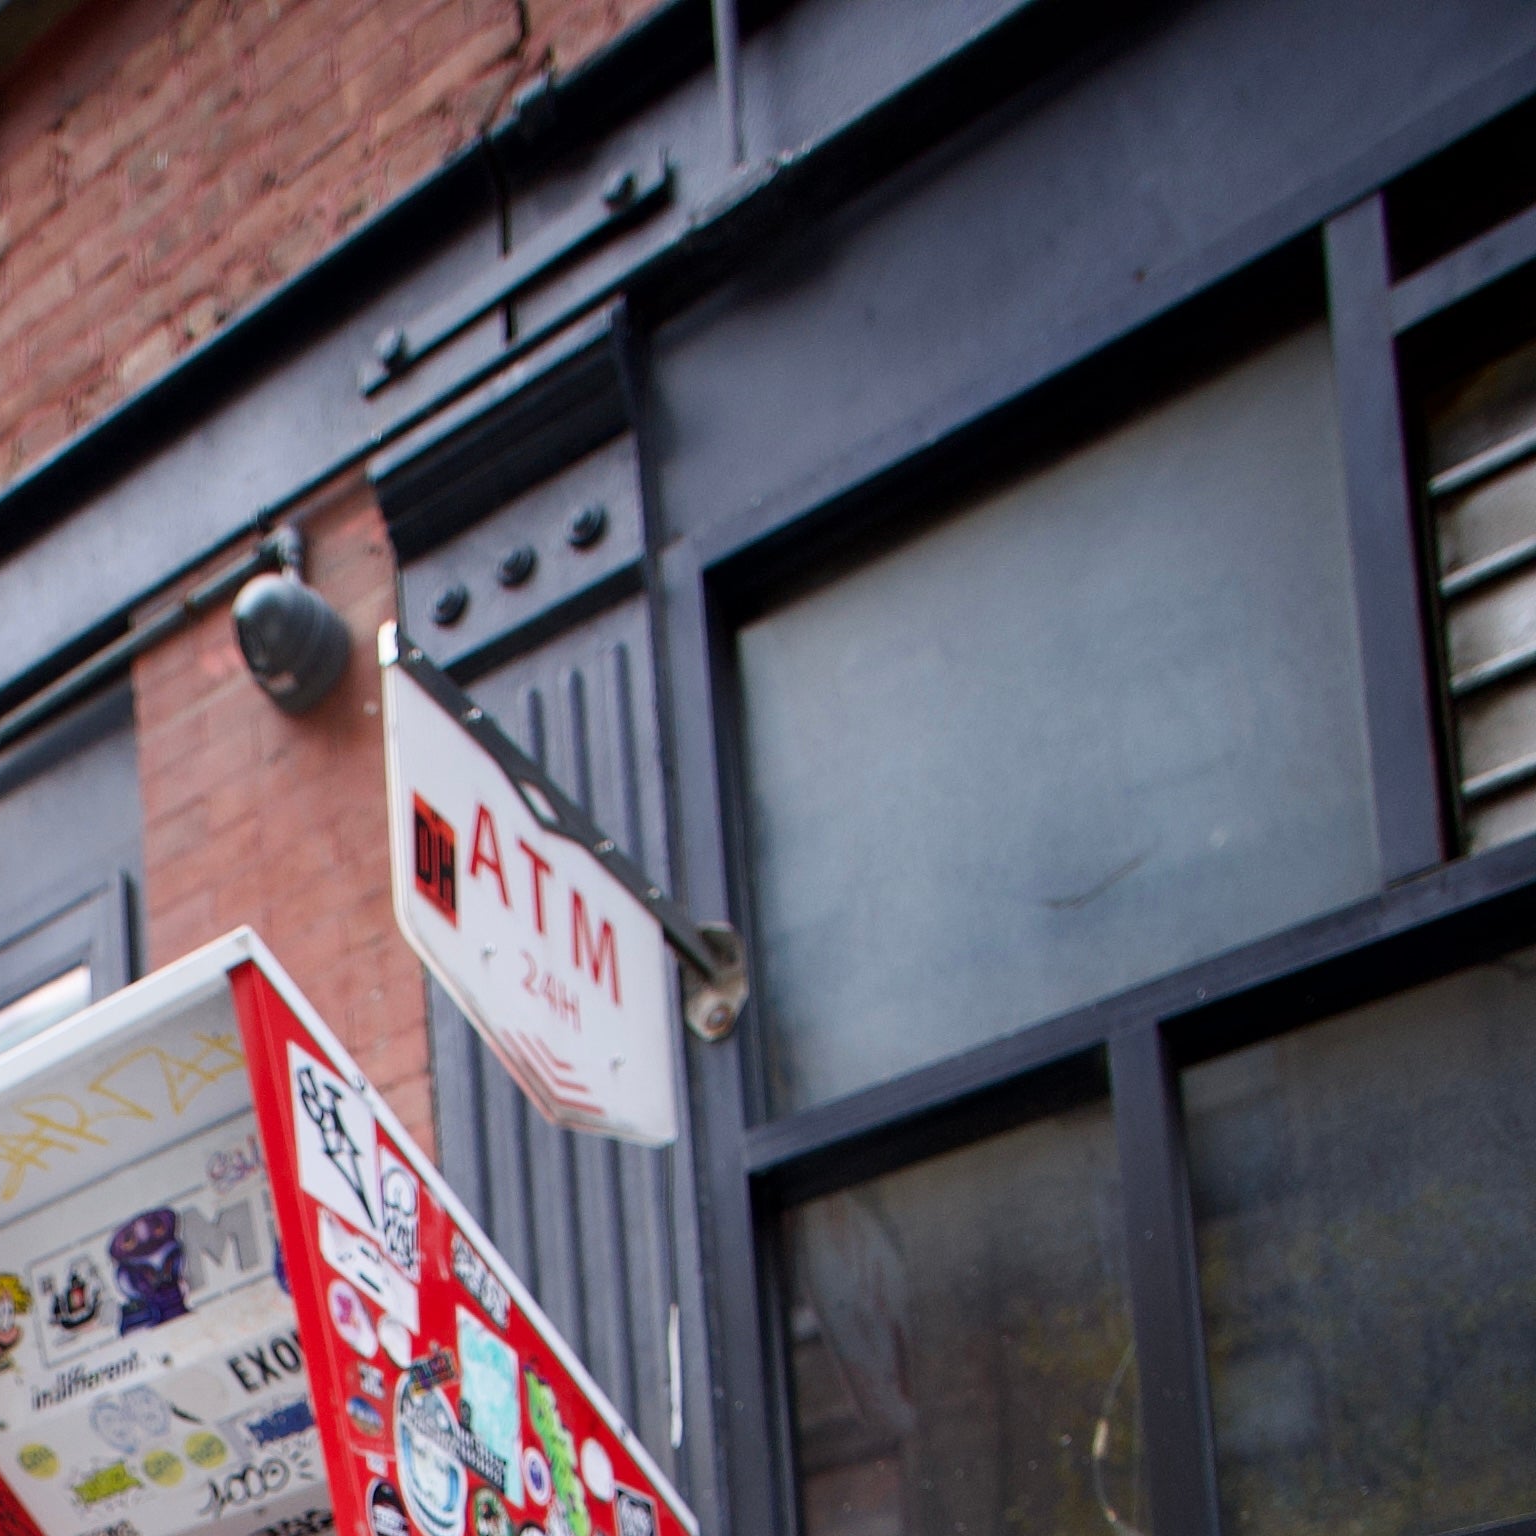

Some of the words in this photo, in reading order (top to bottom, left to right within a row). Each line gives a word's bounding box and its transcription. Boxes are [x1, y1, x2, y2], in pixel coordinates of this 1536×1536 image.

[469, 803, 622, 1007] ATM
[520, 951, 582, 1032] 24H
[227, 1331, 303, 1395] EXO
